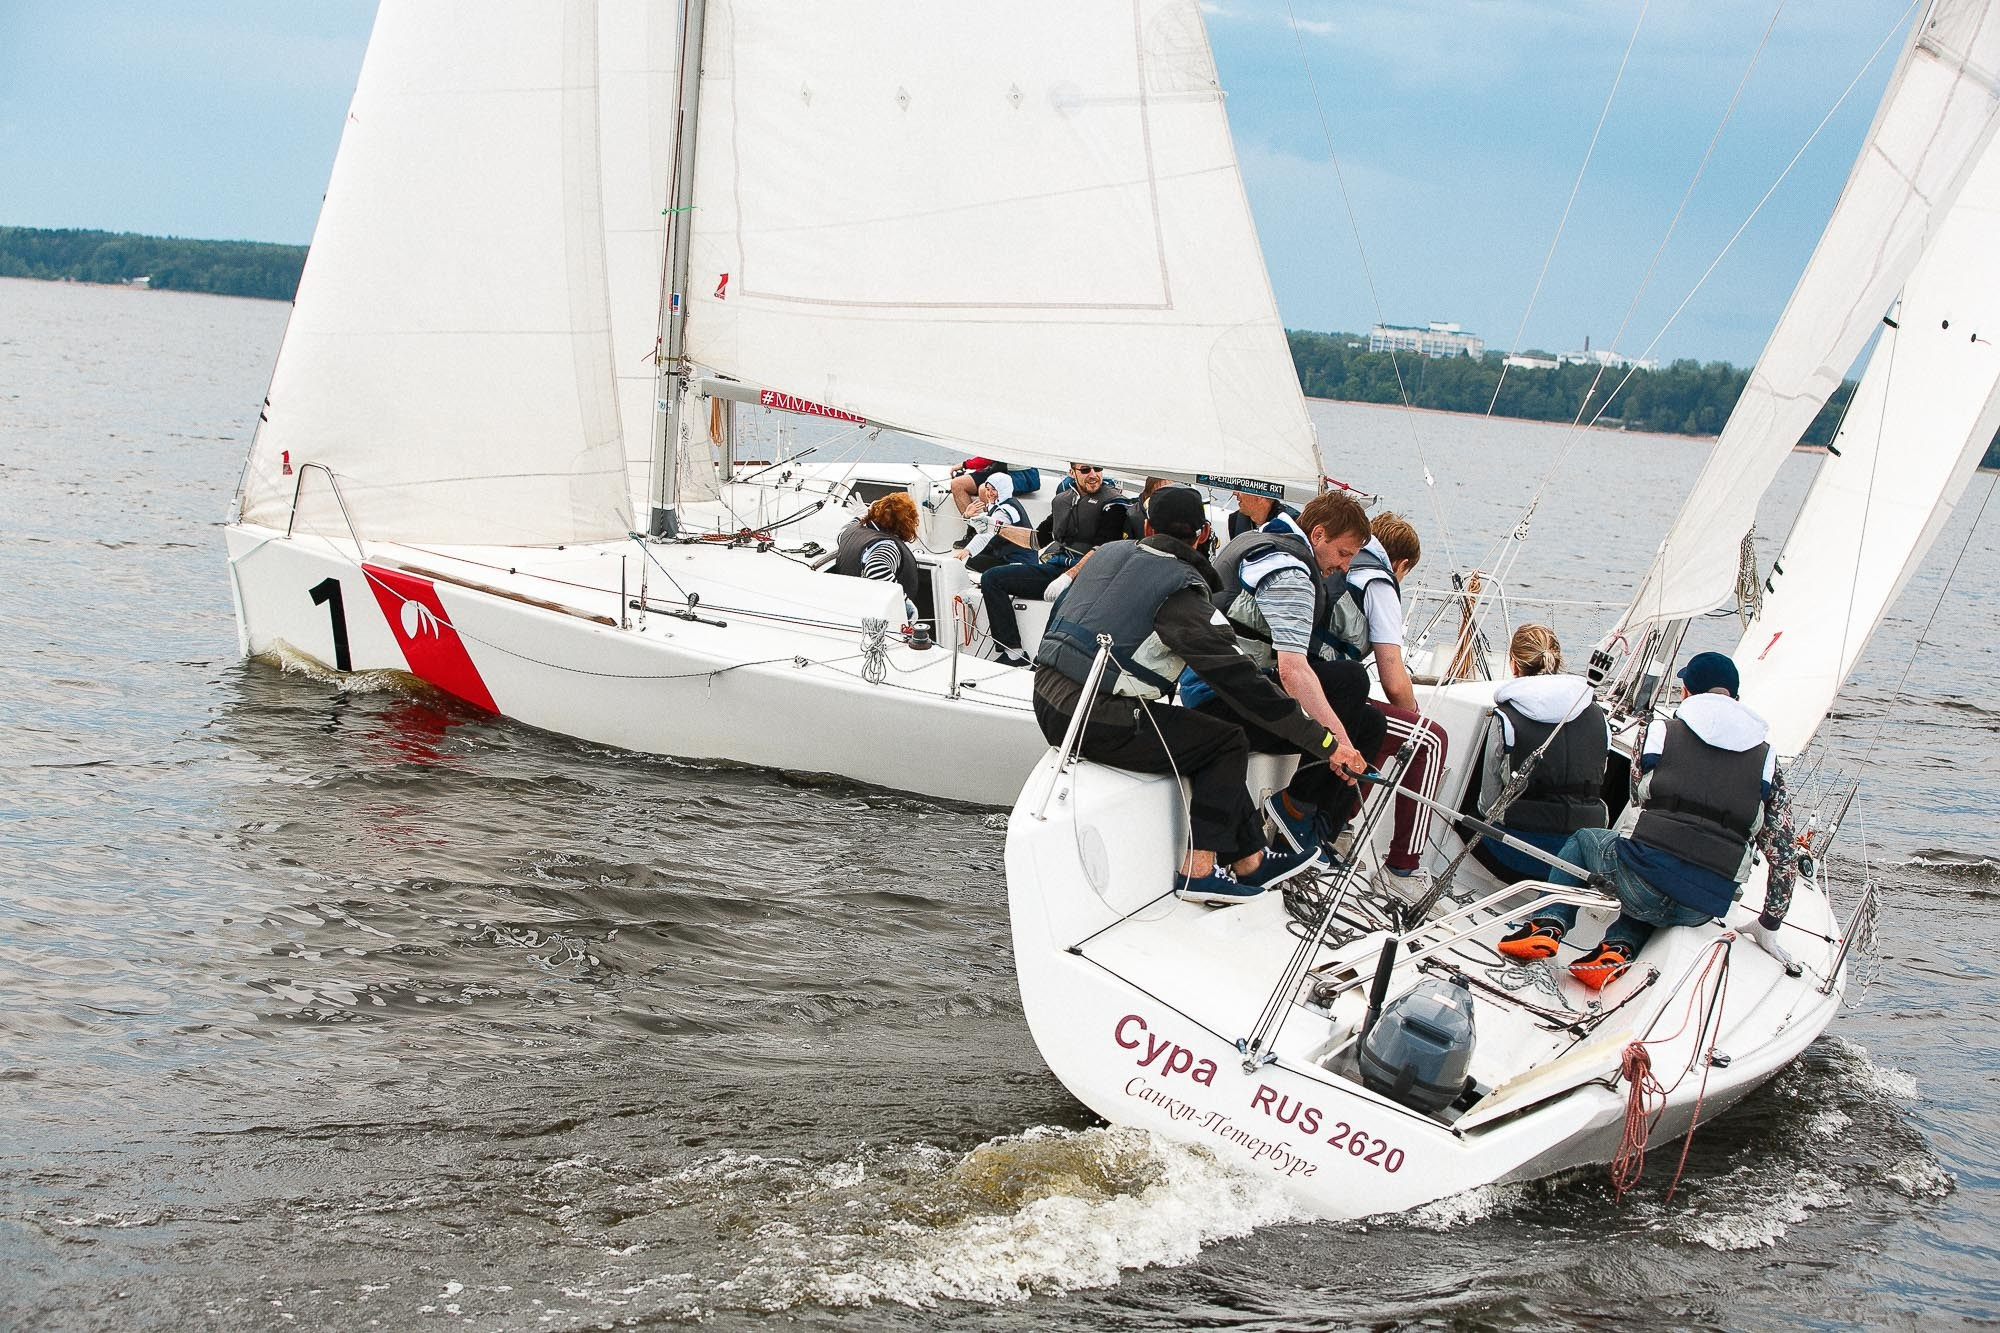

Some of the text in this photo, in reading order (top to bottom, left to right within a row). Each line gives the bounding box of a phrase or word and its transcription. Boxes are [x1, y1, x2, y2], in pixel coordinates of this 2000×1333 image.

[1269, 485, 1284, 494] ЯХТ
[308, 577, 352, 671] 1
[1114, 1014, 1218, 1087] Сура
[1125, 1077, 1318, 1177] Санкт-Петербург
[1250, 1084, 1405, 1173] RUS 2620
